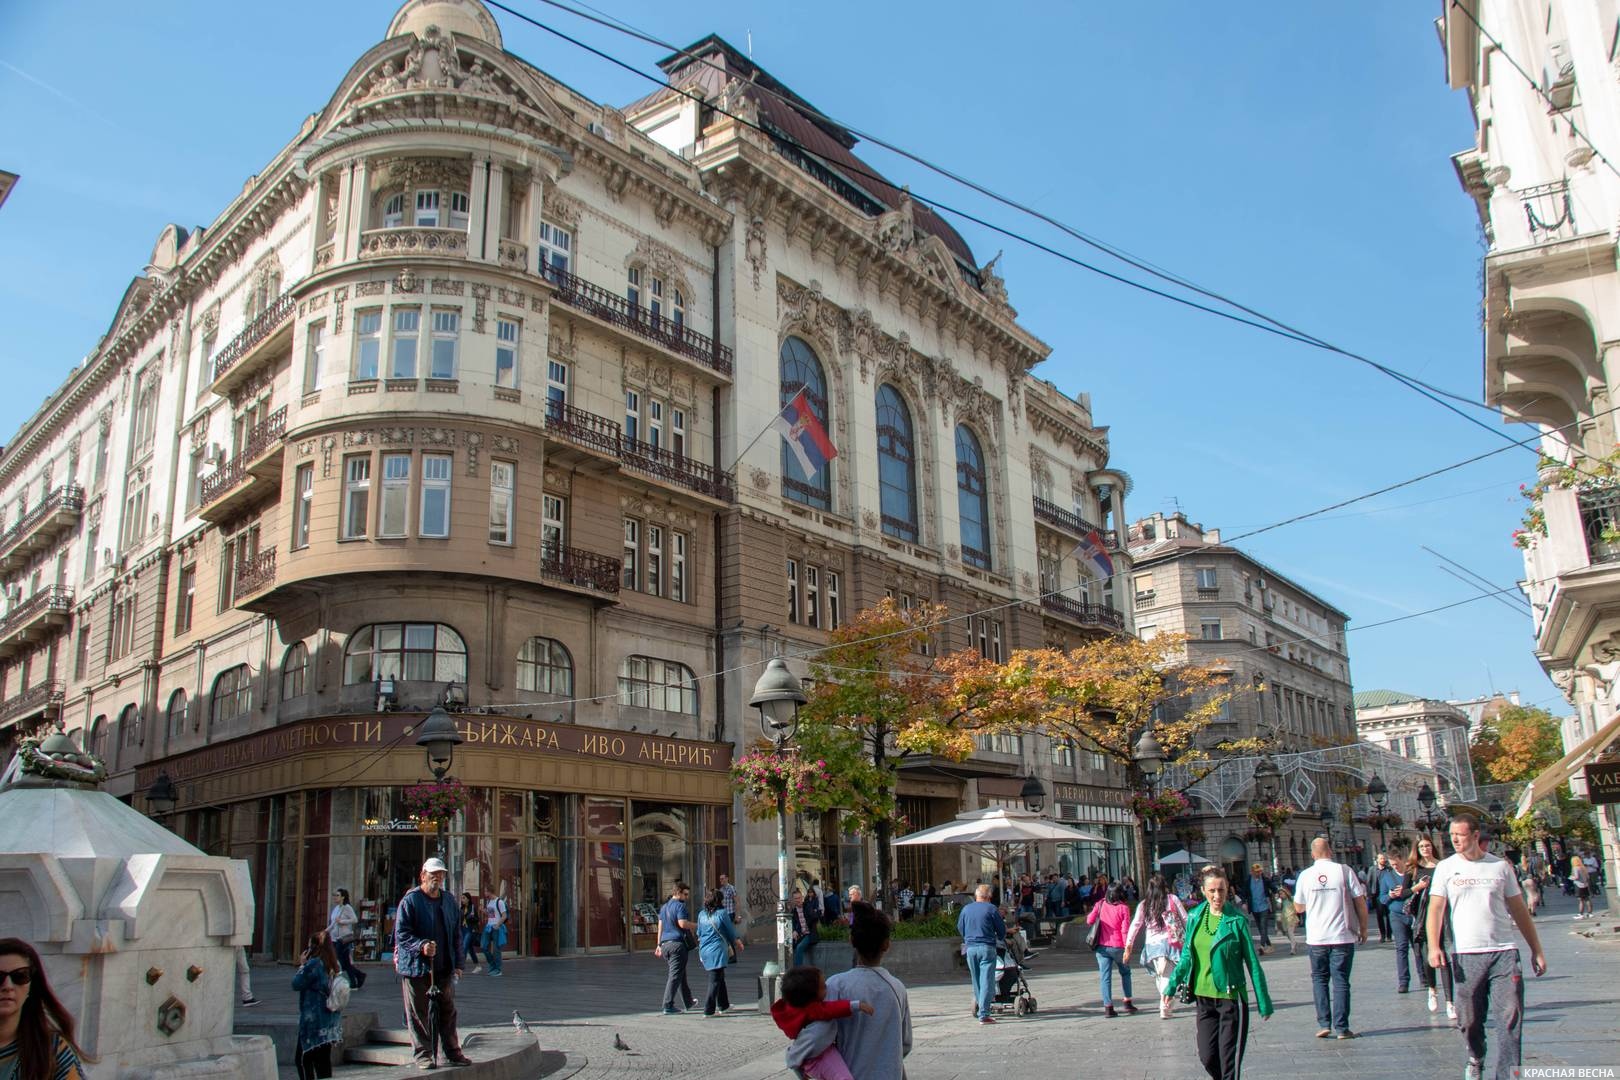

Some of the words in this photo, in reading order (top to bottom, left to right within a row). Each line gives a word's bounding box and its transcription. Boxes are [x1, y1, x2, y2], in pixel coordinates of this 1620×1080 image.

[272, 720, 382, 754] УМЕТНОСТИ
[455, 721, 560, 750] ЊИЖАРА
[1055, 786, 1094, 801] АЛЕРИЈА
